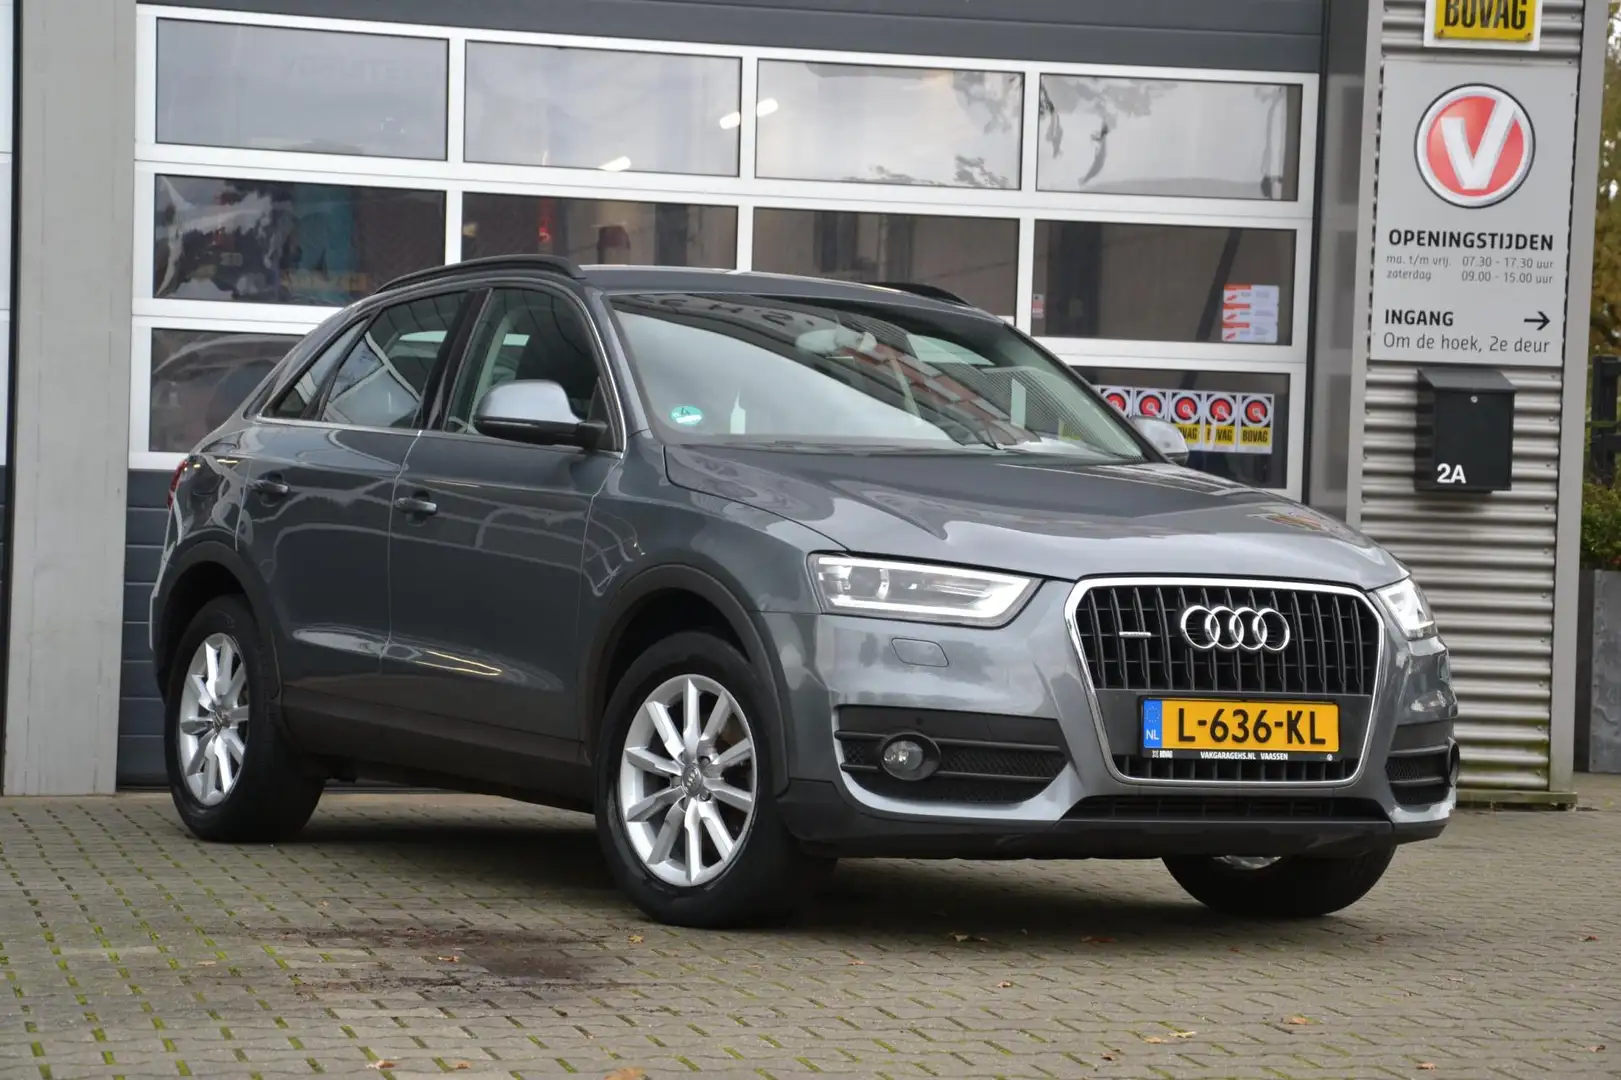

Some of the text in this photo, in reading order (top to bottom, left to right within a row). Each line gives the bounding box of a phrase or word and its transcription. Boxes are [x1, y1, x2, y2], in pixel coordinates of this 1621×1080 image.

[1444, 0, 1527, 30] BOVAG
[1388, 228, 1553, 251] OPENINGSTIJDEN
[1409, 255, 1430, 266] t/m
[1432, 257, 1452, 269] vrij.
[1462, 256, 1492, 268] 07.30
[1504, 257, 1534, 269] 17.30
[1536, 261, 1553, 269] uur
[1387, 269, 1432, 282] zaterdag
[1461, 270, 1491, 283] 09.00
[1504, 272, 1533, 284] 15.00
[1535, 275, 1553, 284] uur
[1384, 309, 1455, 327] INGANG
[1383, 332, 1551, 353] Om de hoek, 2e deur
[1242, 430, 1268, 443] BOVAG
[1437, 463, 1467, 484] 2A
[1145, 729, 1160, 741] NL
[1178, 708, 1326, 745] L-636-KL
